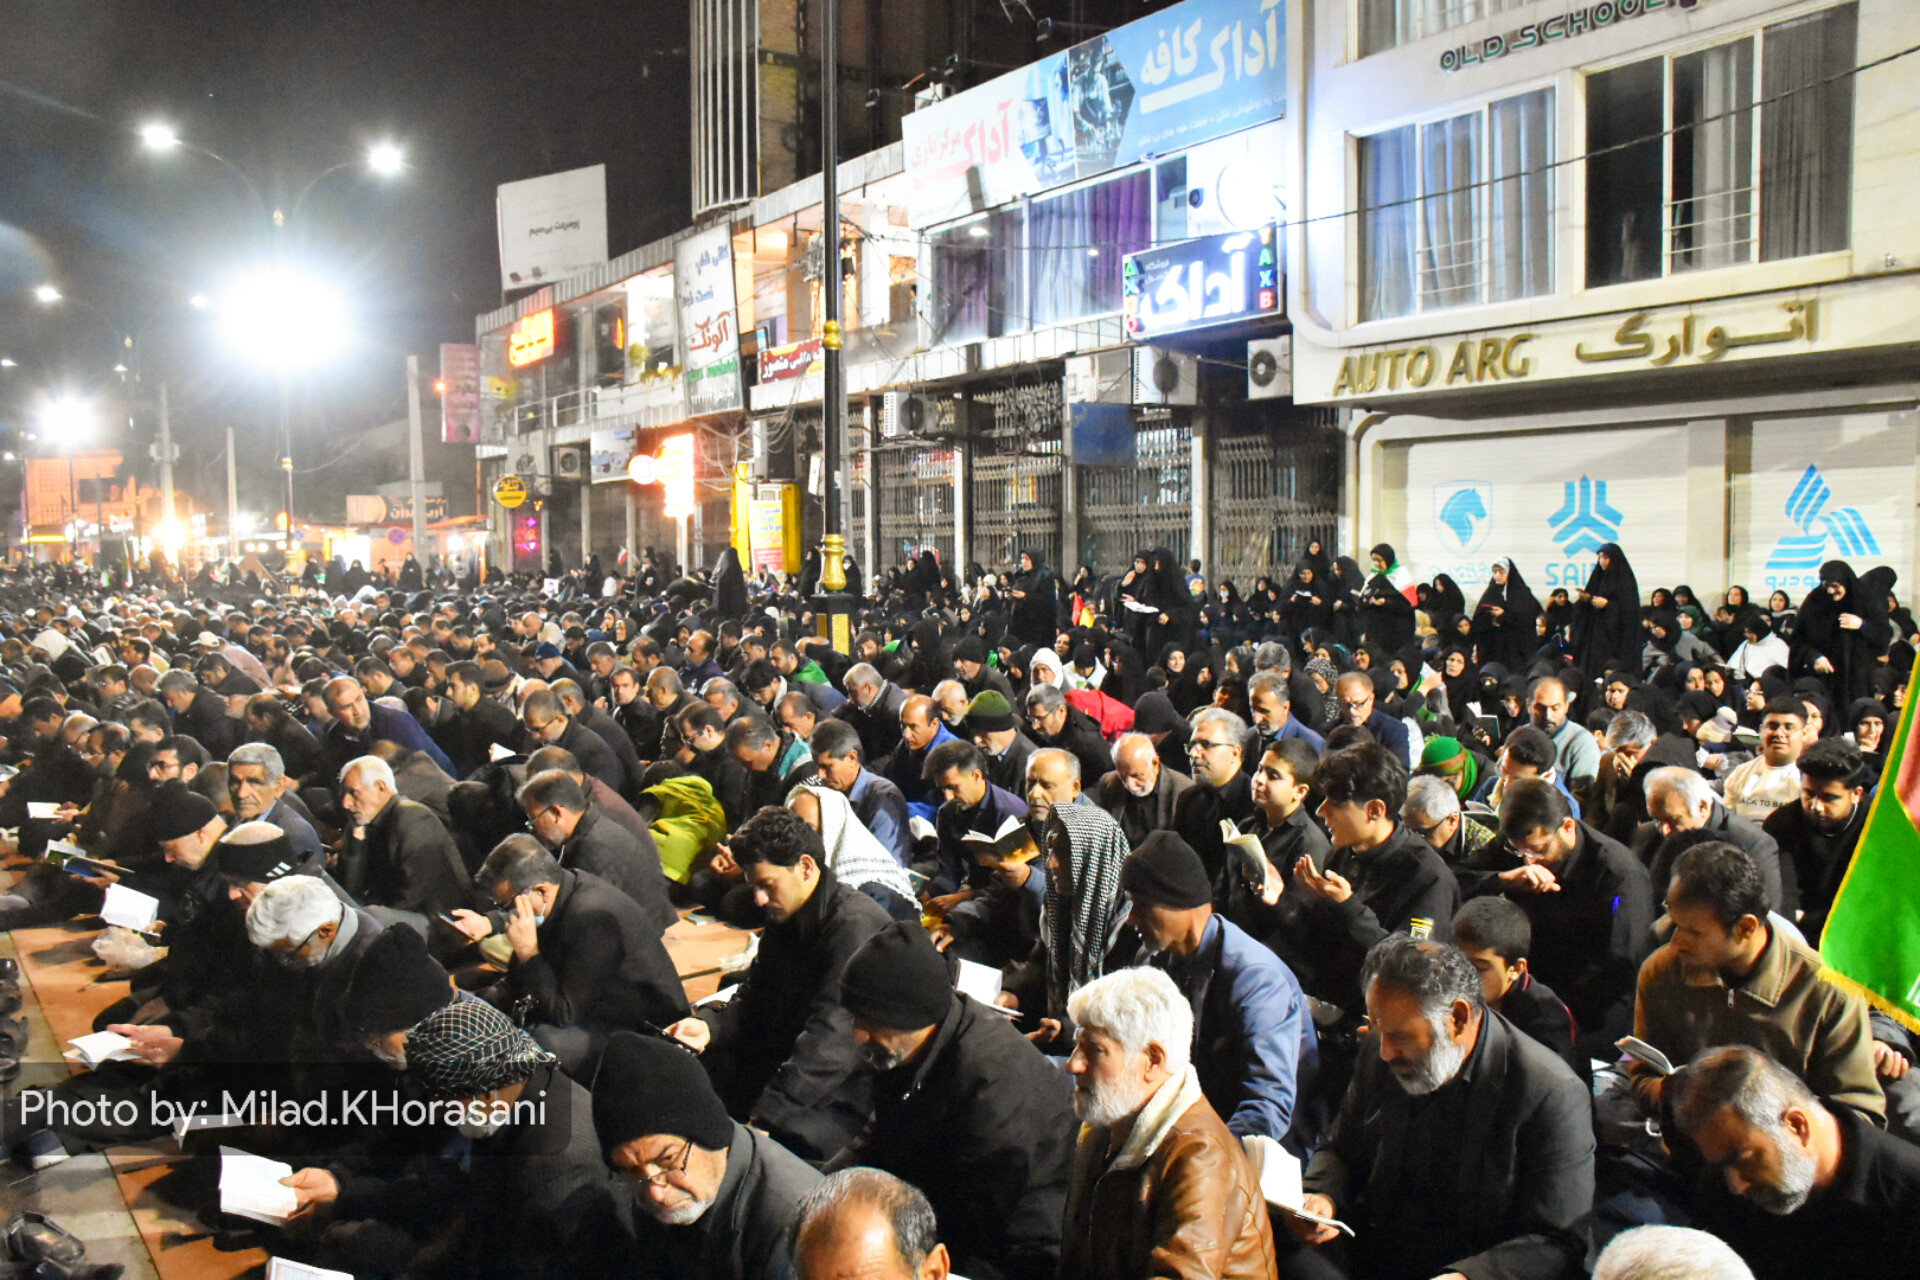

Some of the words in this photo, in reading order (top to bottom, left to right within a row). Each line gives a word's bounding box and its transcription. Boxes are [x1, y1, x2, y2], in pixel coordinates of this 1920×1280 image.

[1141, 17, 1202, 86] کافه
[1440, 35, 1505, 71] OLD
[1331, 344, 1436, 397] AUTO
[1445, 333, 1538, 386] ARG
[1545, 563, 1598, 586] SAI
